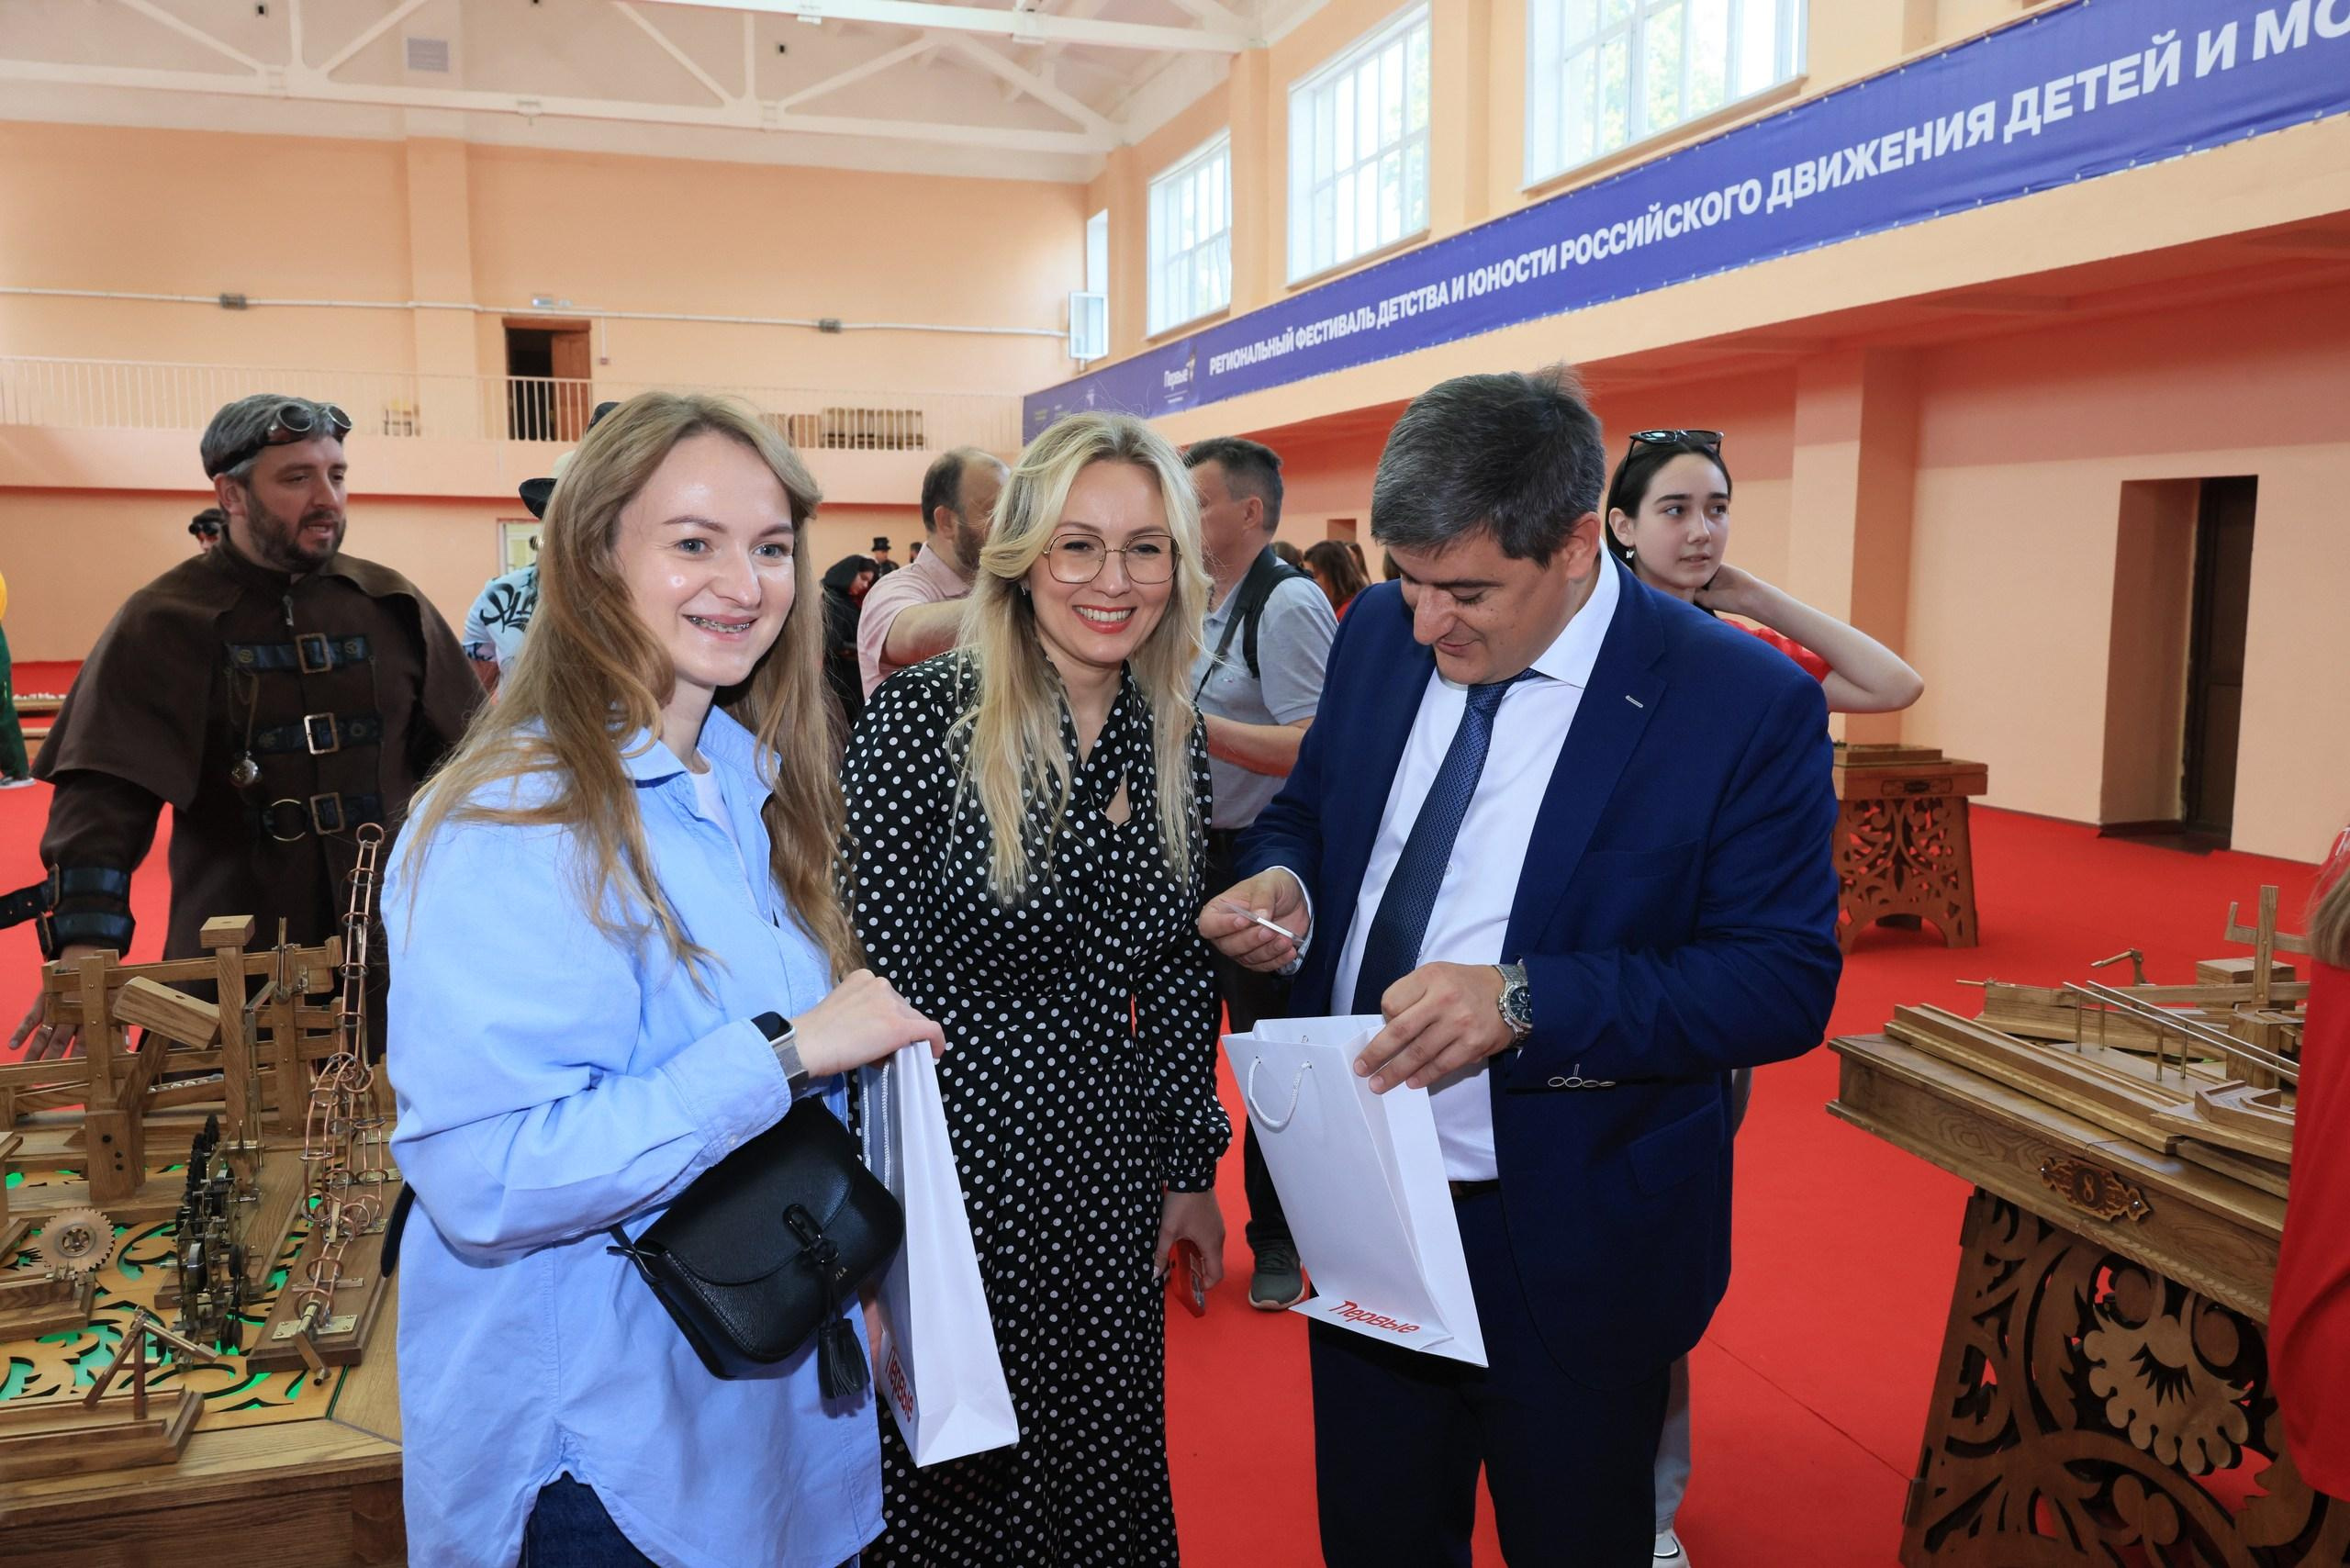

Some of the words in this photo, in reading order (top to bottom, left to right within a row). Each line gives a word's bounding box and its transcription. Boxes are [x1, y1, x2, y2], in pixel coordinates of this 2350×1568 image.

[1209, 326, 1294, 376] РЕГИОНАЛЬНЫЙ
[1295, 306, 1377, 350] ФЕСТИВАЛЬ
[1377, 280, 1449, 330] ДЕТСТВА
[1451, 274, 1465, 303] И
[1467, 244, 1557, 298] ЮНОСТИ
[1561, 179, 1762, 270] РОССИЙСКОГО
[1766, 100, 1997, 214] ДВИЖЕНИЯ
[2003, 28, 2182, 144] ДЕТЕЙ
[2195, 20, 2238, 78] И
[1328, 1299, 1421, 1334] Первые
[884, 1345, 913, 1423] Первые
